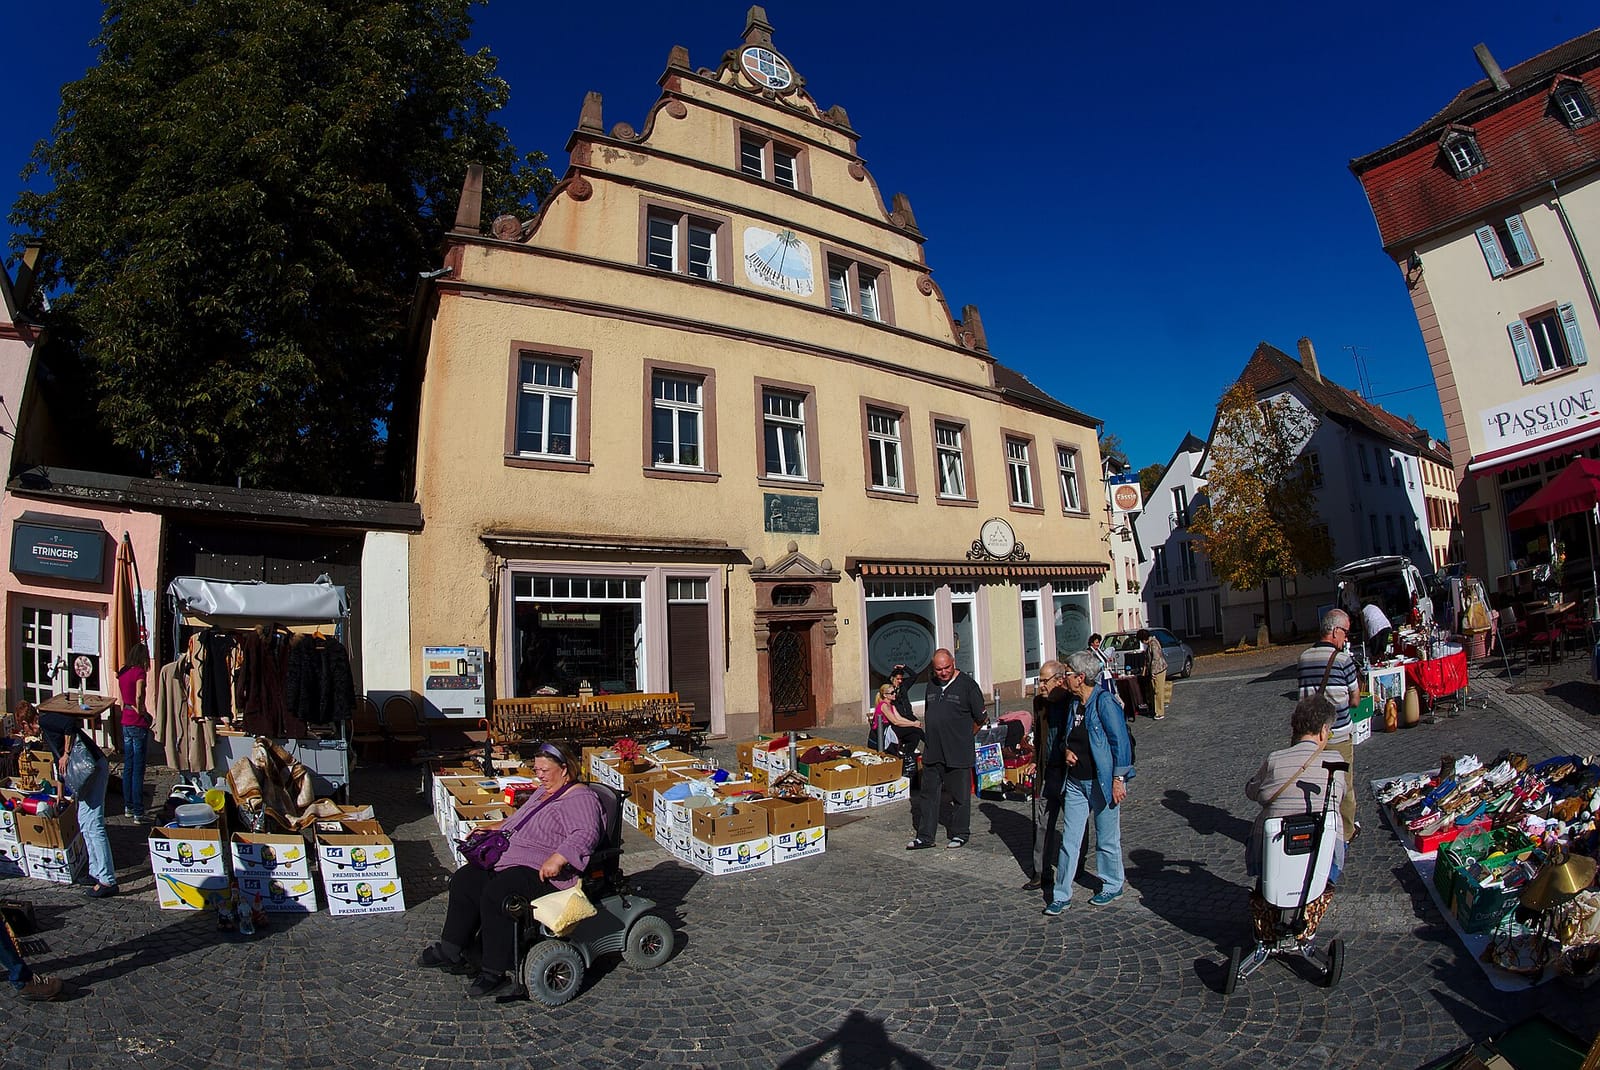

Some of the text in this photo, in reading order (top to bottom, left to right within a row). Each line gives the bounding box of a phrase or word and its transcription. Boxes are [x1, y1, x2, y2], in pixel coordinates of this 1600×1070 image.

[1487, 389, 1595, 437] LA PASSIONE
[1525, 417, 1569, 437] DEL GELATO
[32, 546, 79, 559] ETRINGERS
